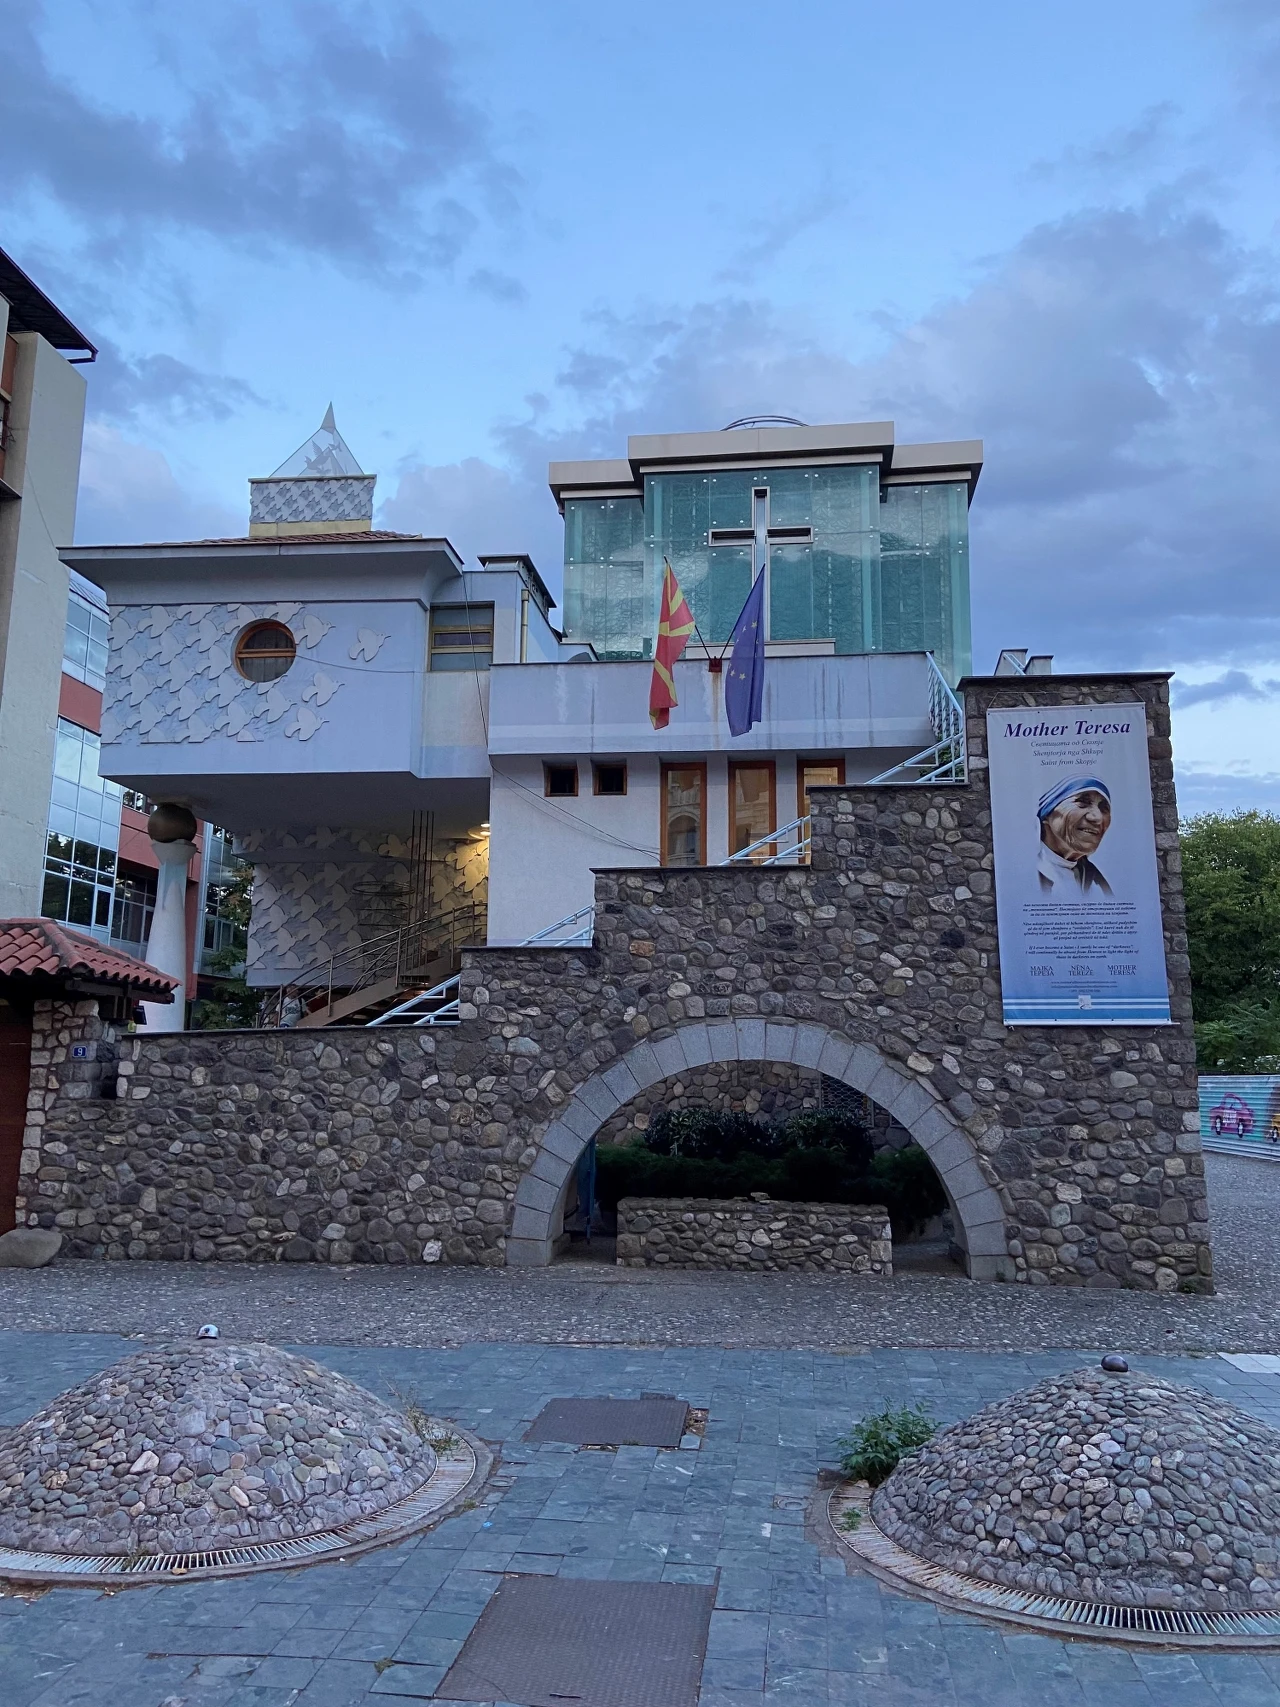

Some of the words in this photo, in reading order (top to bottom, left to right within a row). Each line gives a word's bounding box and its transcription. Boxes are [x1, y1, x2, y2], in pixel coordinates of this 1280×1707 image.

[1004, 722, 1068, 737] Mother
[1075, 720, 1130, 735] Teresa
[1067, 748, 1080, 756] nga
[1059, 758, 1074, 766] from
[77, 1047, 83, 1056] 9
